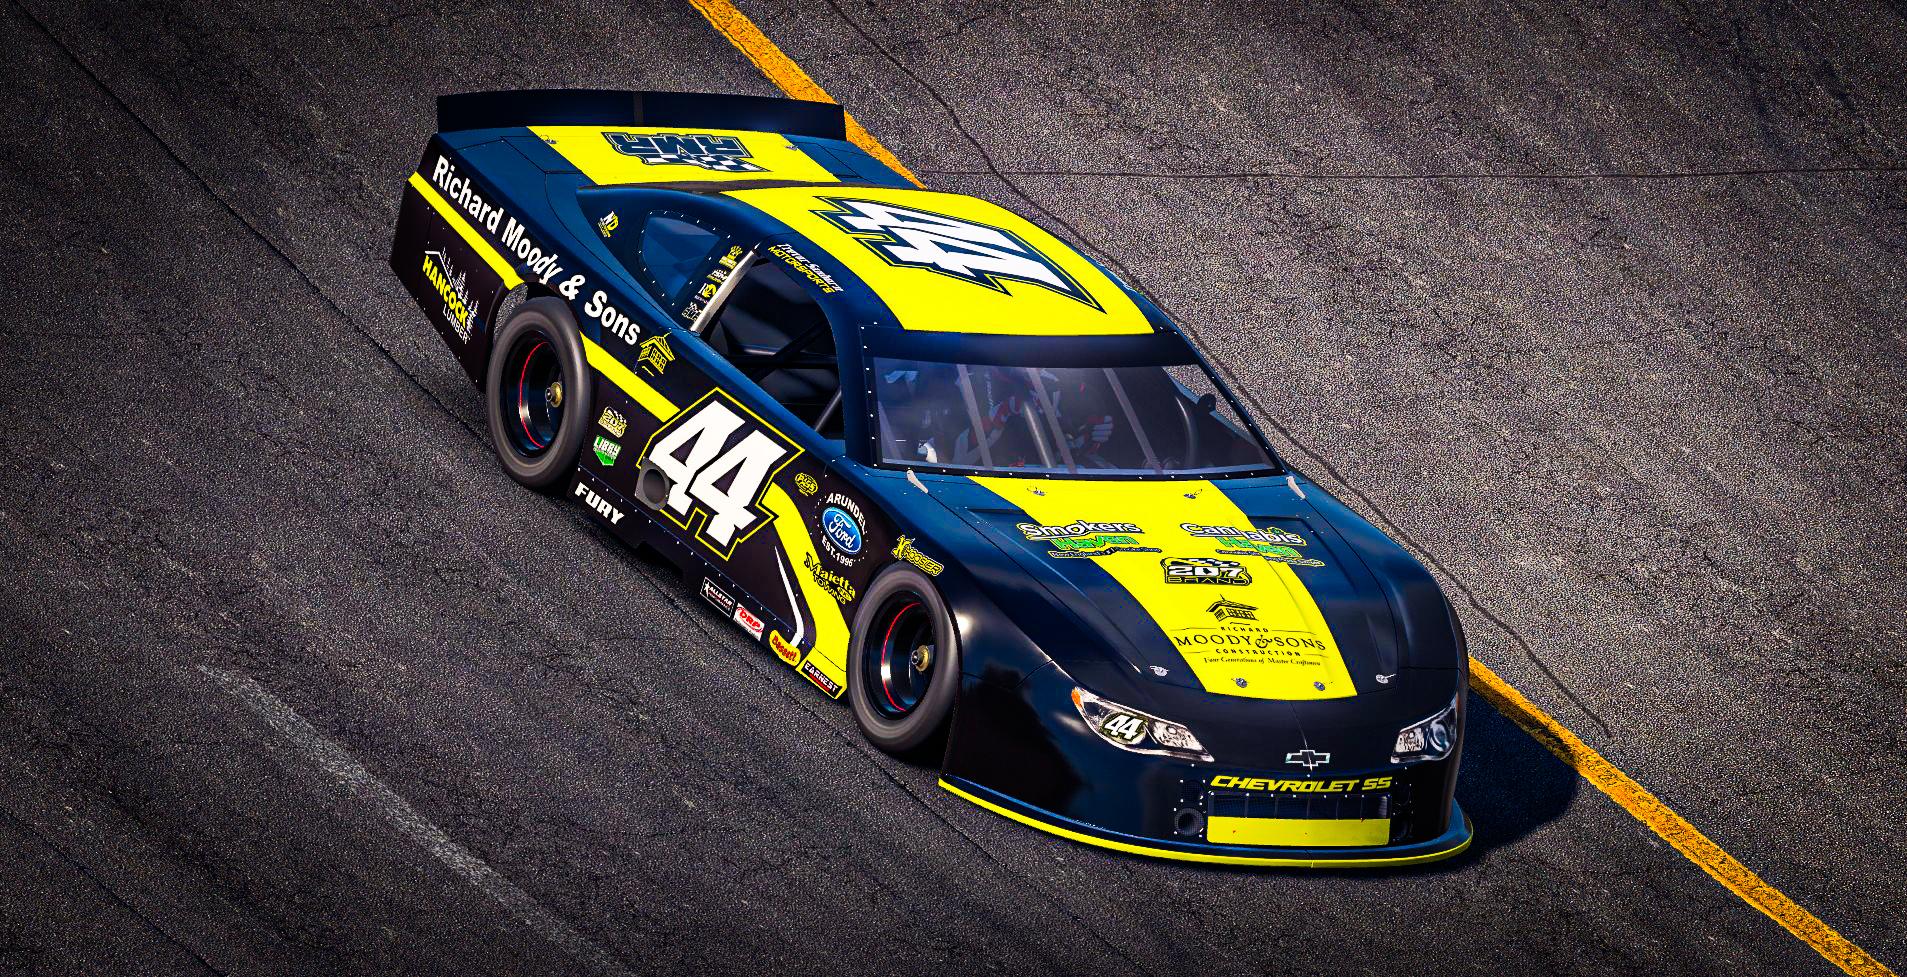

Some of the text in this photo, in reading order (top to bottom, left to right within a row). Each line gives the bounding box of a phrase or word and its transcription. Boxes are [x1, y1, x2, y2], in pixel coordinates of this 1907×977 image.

[432, 155, 641, 346] Richard Moody & Sons
[832, 199, 1076, 294] 44
[767, 245, 836, 293] MOTORSPORTS
[422, 255, 468, 328] HANCOCK
[443, 303, 470, 344] LUMBER
[648, 400, 788, 547] 44
[574, 482, 624, 525] FURY
[826, 493, 866, 535] ARUNDEL
[829, 513, 854, 549] Ford
[1019, 520, 1144, 538] Smokers
[804, 552, 856, 599] Maietta
[1167, 565, 1245, 577] 207
[1167, 576, 1248, 585] BRAND
[813, 572, 846, 605] TOWING
[739, 609, 761, 629] DRP
[1173, 634, 1326, 651] MOODY & SONS
[1215, 648, 1301, 657] CONSTRUCTION
[804, 662, 838, 692] EARNEST
[1103, 714, 1144, 740] 44
[1211, 775, 1393, 792] CHEVROLET SS
